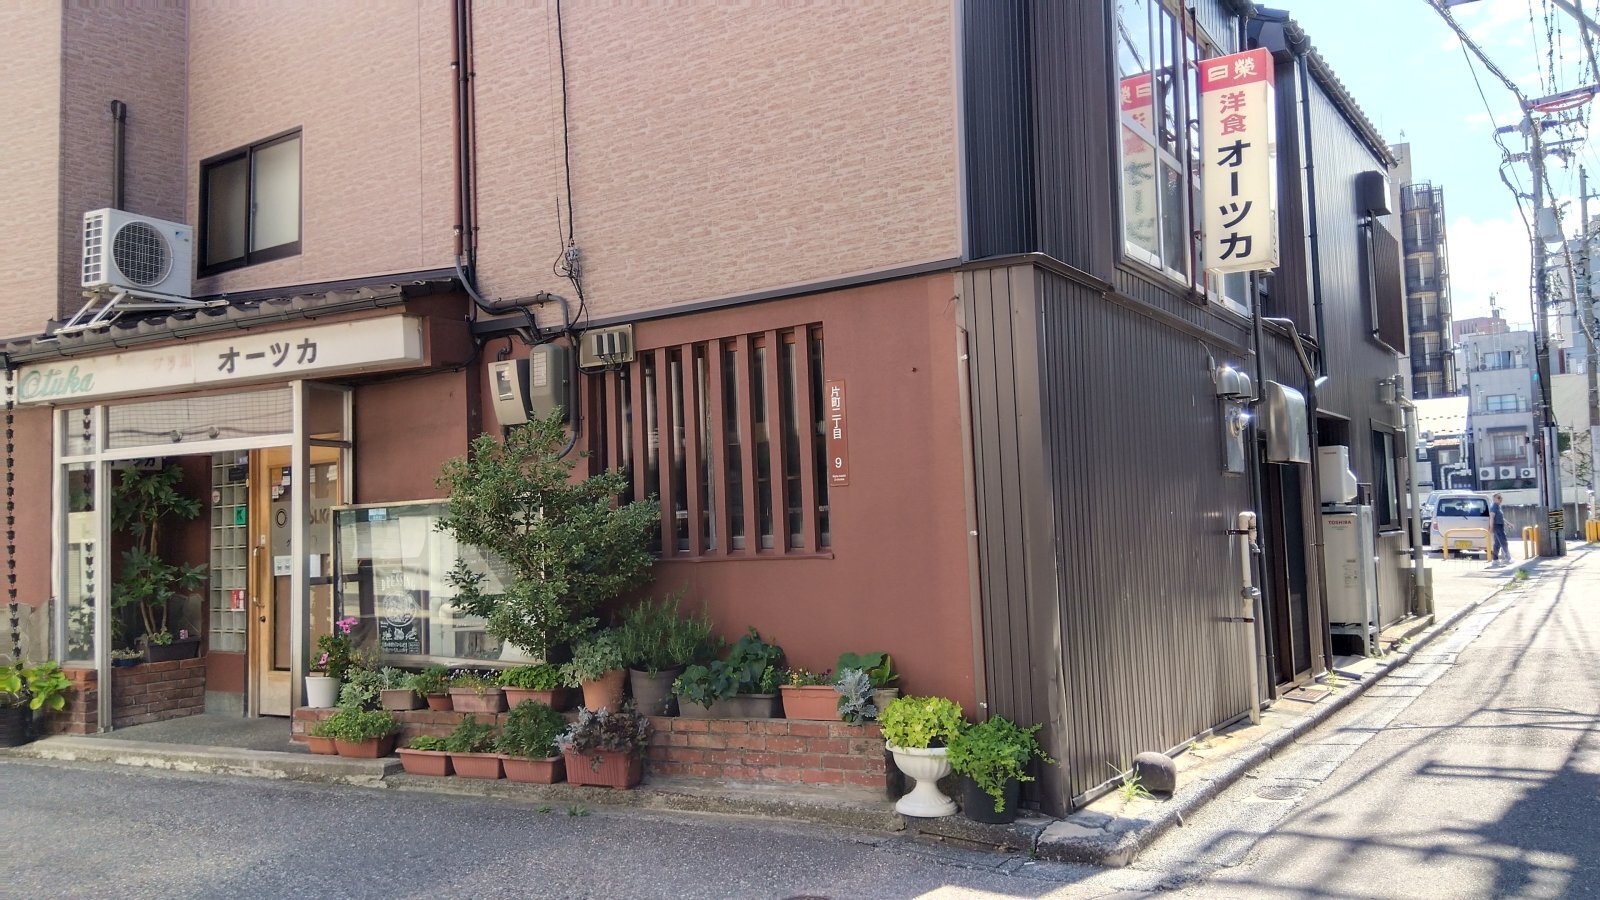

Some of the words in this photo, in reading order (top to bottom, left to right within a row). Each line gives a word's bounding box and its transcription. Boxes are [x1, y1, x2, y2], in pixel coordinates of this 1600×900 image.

[1220, 91, 1246, 136] 洋食
[1217, 139, 1252, 261] オーツカ
[218, 338, 317, 373] オーツカ
[831, 386, 842, 439] 片町二丁目
[835, 457, 842, 468] 9
